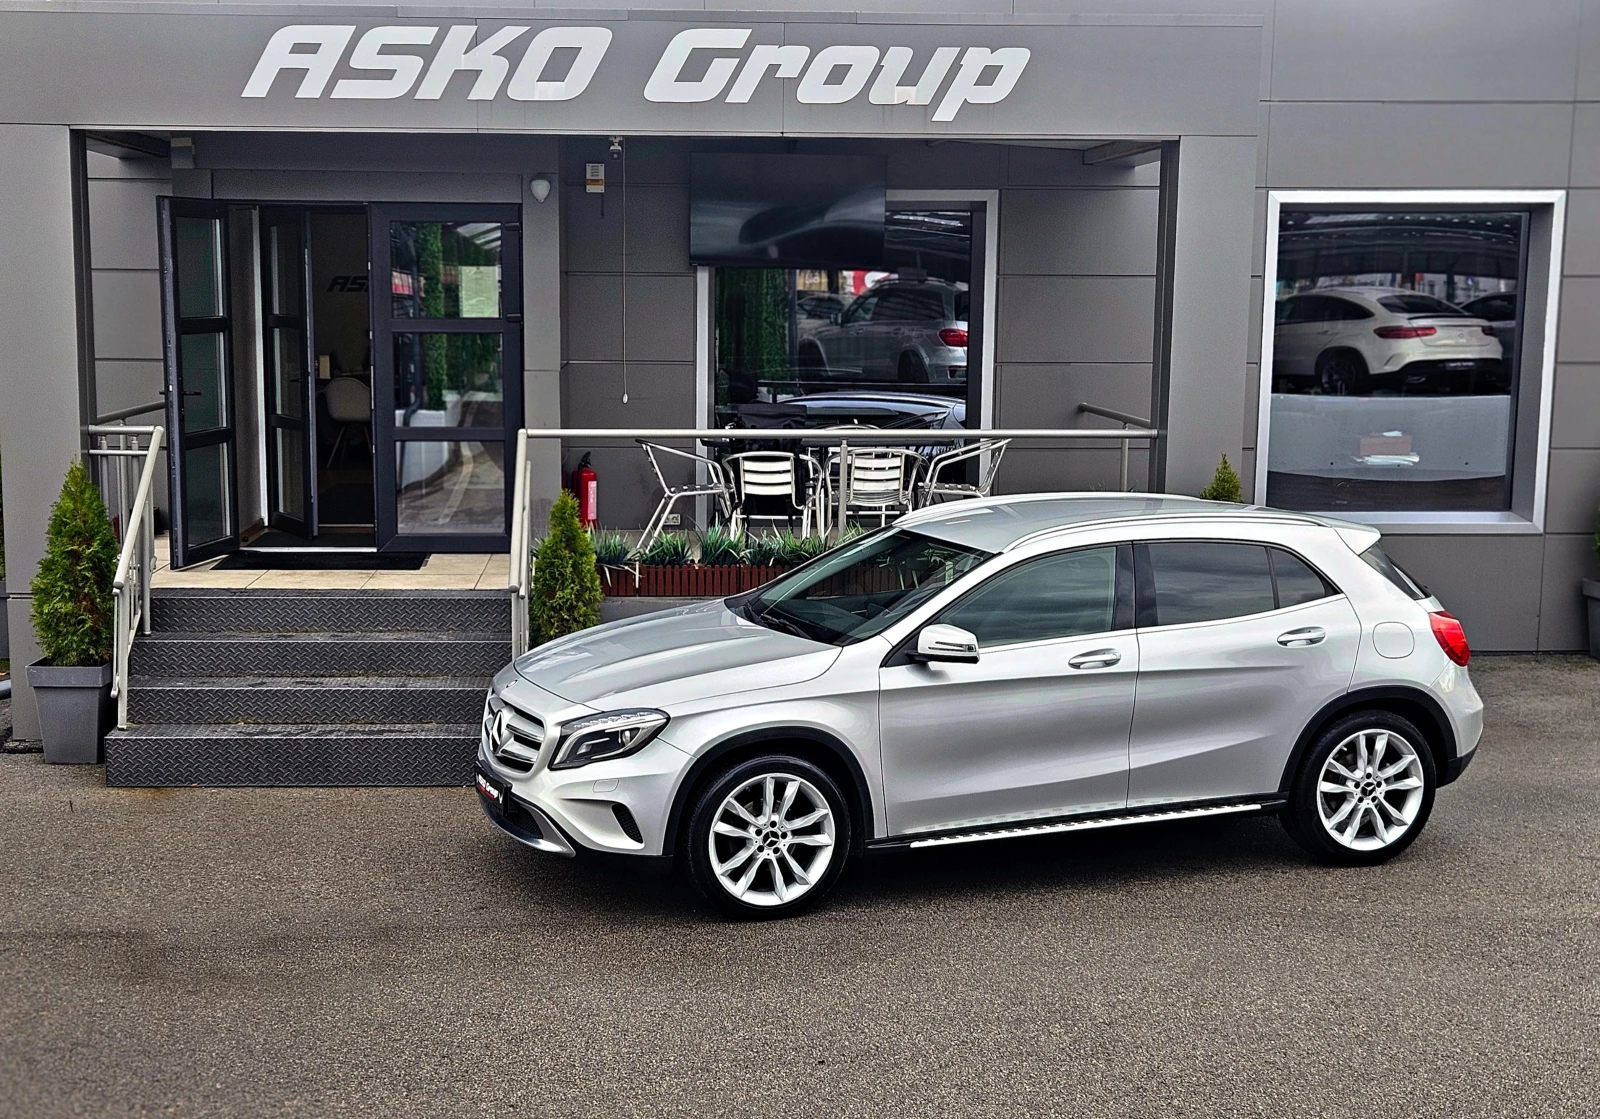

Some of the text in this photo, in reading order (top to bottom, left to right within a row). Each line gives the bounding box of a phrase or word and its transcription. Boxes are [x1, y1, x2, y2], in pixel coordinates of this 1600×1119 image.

[240, 24, 1031, 122] ASKO Group
[327, 275, 368, 292] AS
